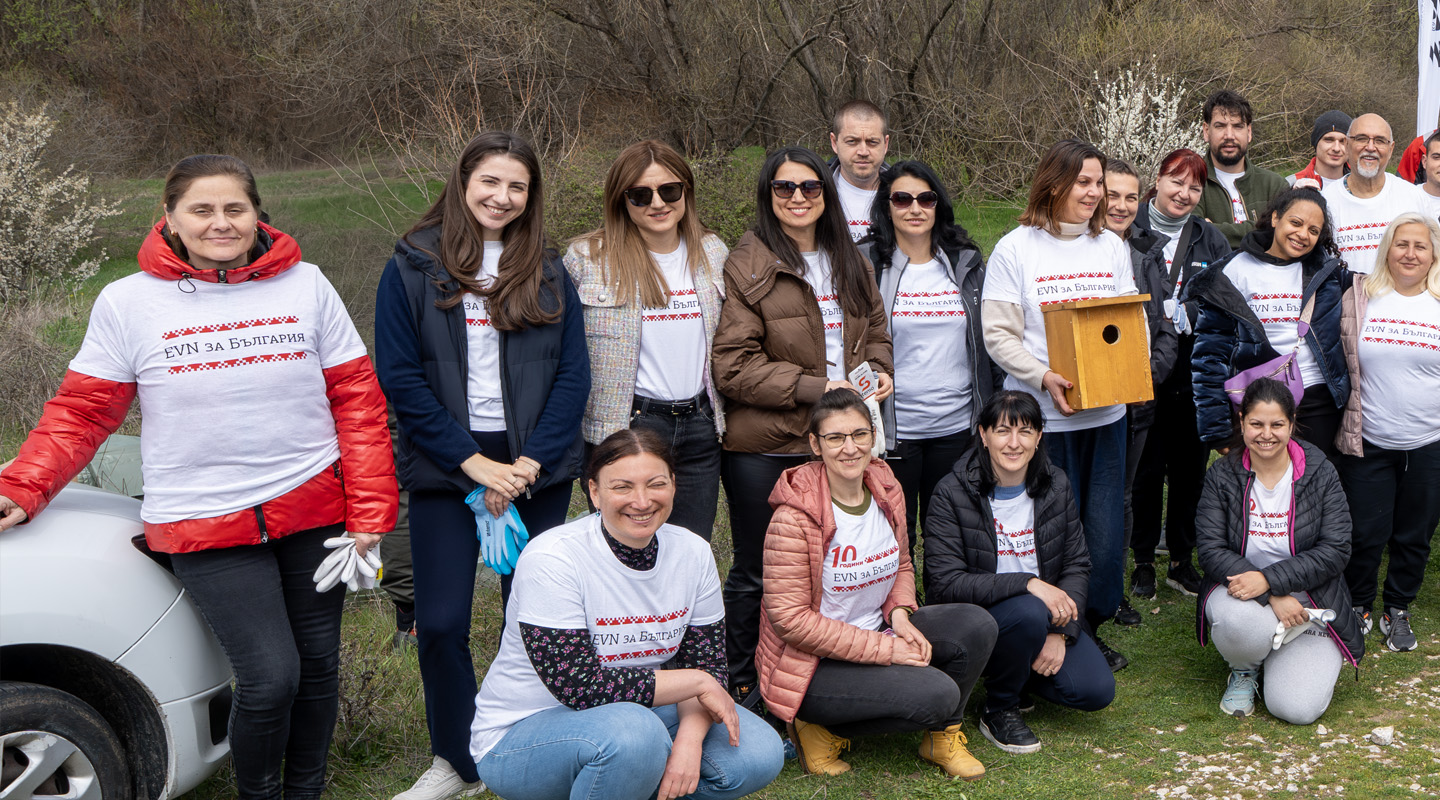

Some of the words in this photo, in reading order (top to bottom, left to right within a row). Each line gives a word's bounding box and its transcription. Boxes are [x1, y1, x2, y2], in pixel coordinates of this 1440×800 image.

[1037, 285, 1059, 296] EVN
[1365, 325, 1386, 334] EVN
[164, 341, 199, 360] EVN
[831, 545, 857, 569] 10
[834, 571, 857, 583] EVN
[592, 633, 620, 646] EVN
